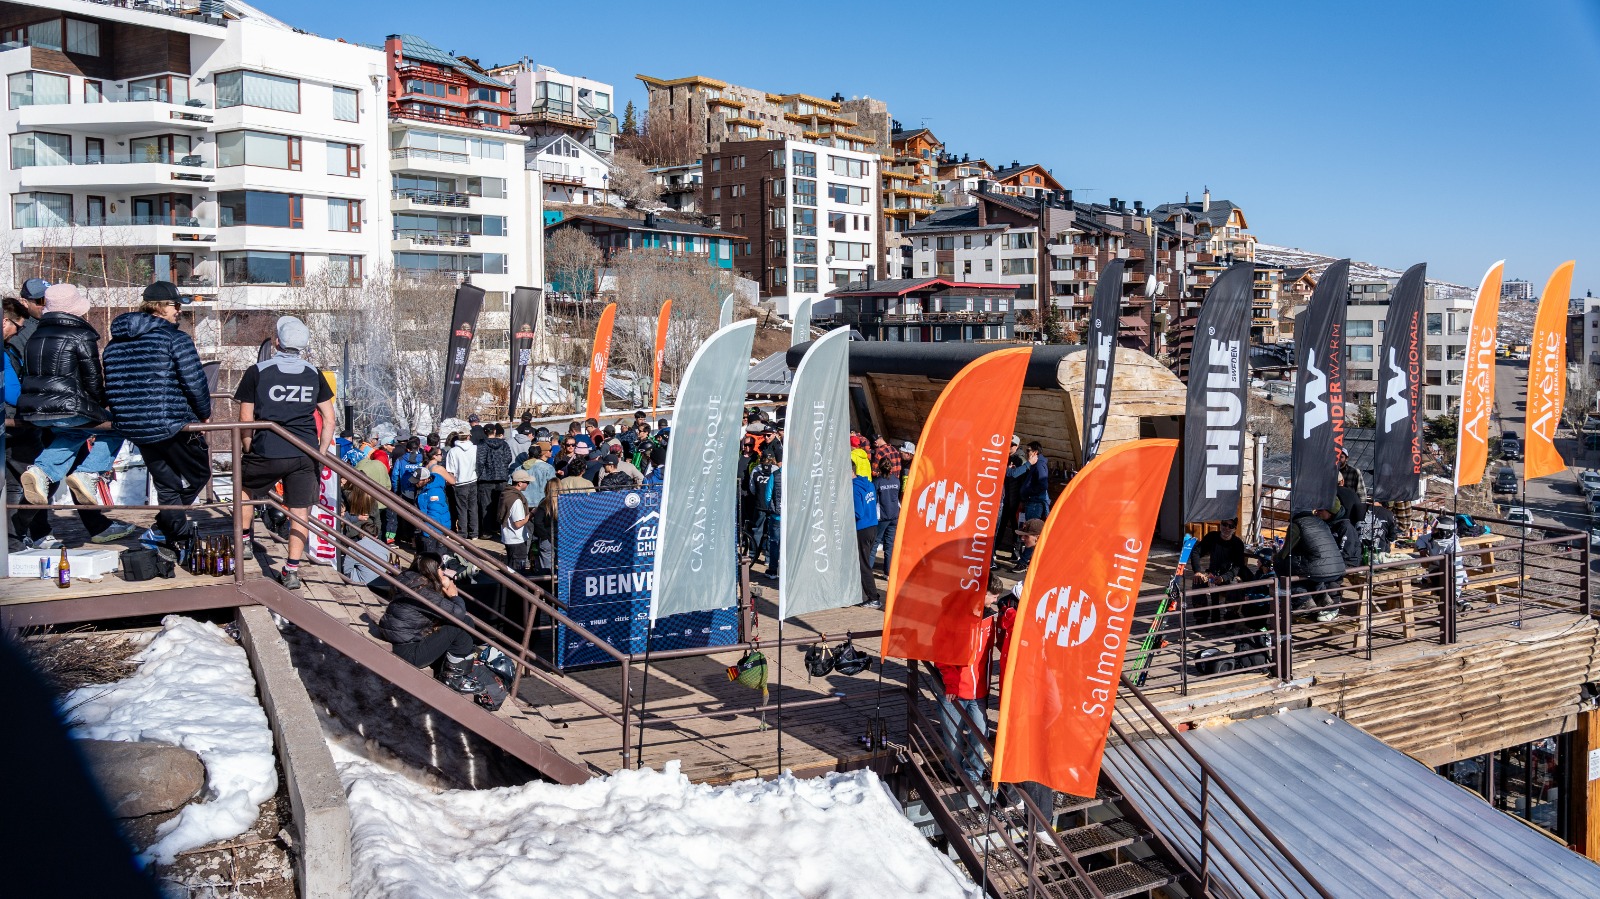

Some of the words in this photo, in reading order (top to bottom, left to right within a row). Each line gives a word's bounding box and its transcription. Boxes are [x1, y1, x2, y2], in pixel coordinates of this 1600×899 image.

[268, 384, 314, 403] CZE
[1408, 311, 1420, 433] CALEFACCIONADA
[1465, 327, 1493, 443] Avène
[1532, 331, 1559, 443] Avène
[1535, 330, 1545, 387] THERMALE
[1205, 338, 1242, 499] THULE
[1411, 436, 1421, 475] ROPA
[690, 506, 707, 572] CASAS
[709, 509, 717, 550] FAMILY
[714, 455, 723, 502] PASSION
[811, 508, 829, 573] CASAS
[960, 433, 1007, 593] SalmonChile
[590, 539, 623, 555] Ford
[590, 618, 608, 626] THULE
[1081, 537, 1143, 718] SalmonChile
